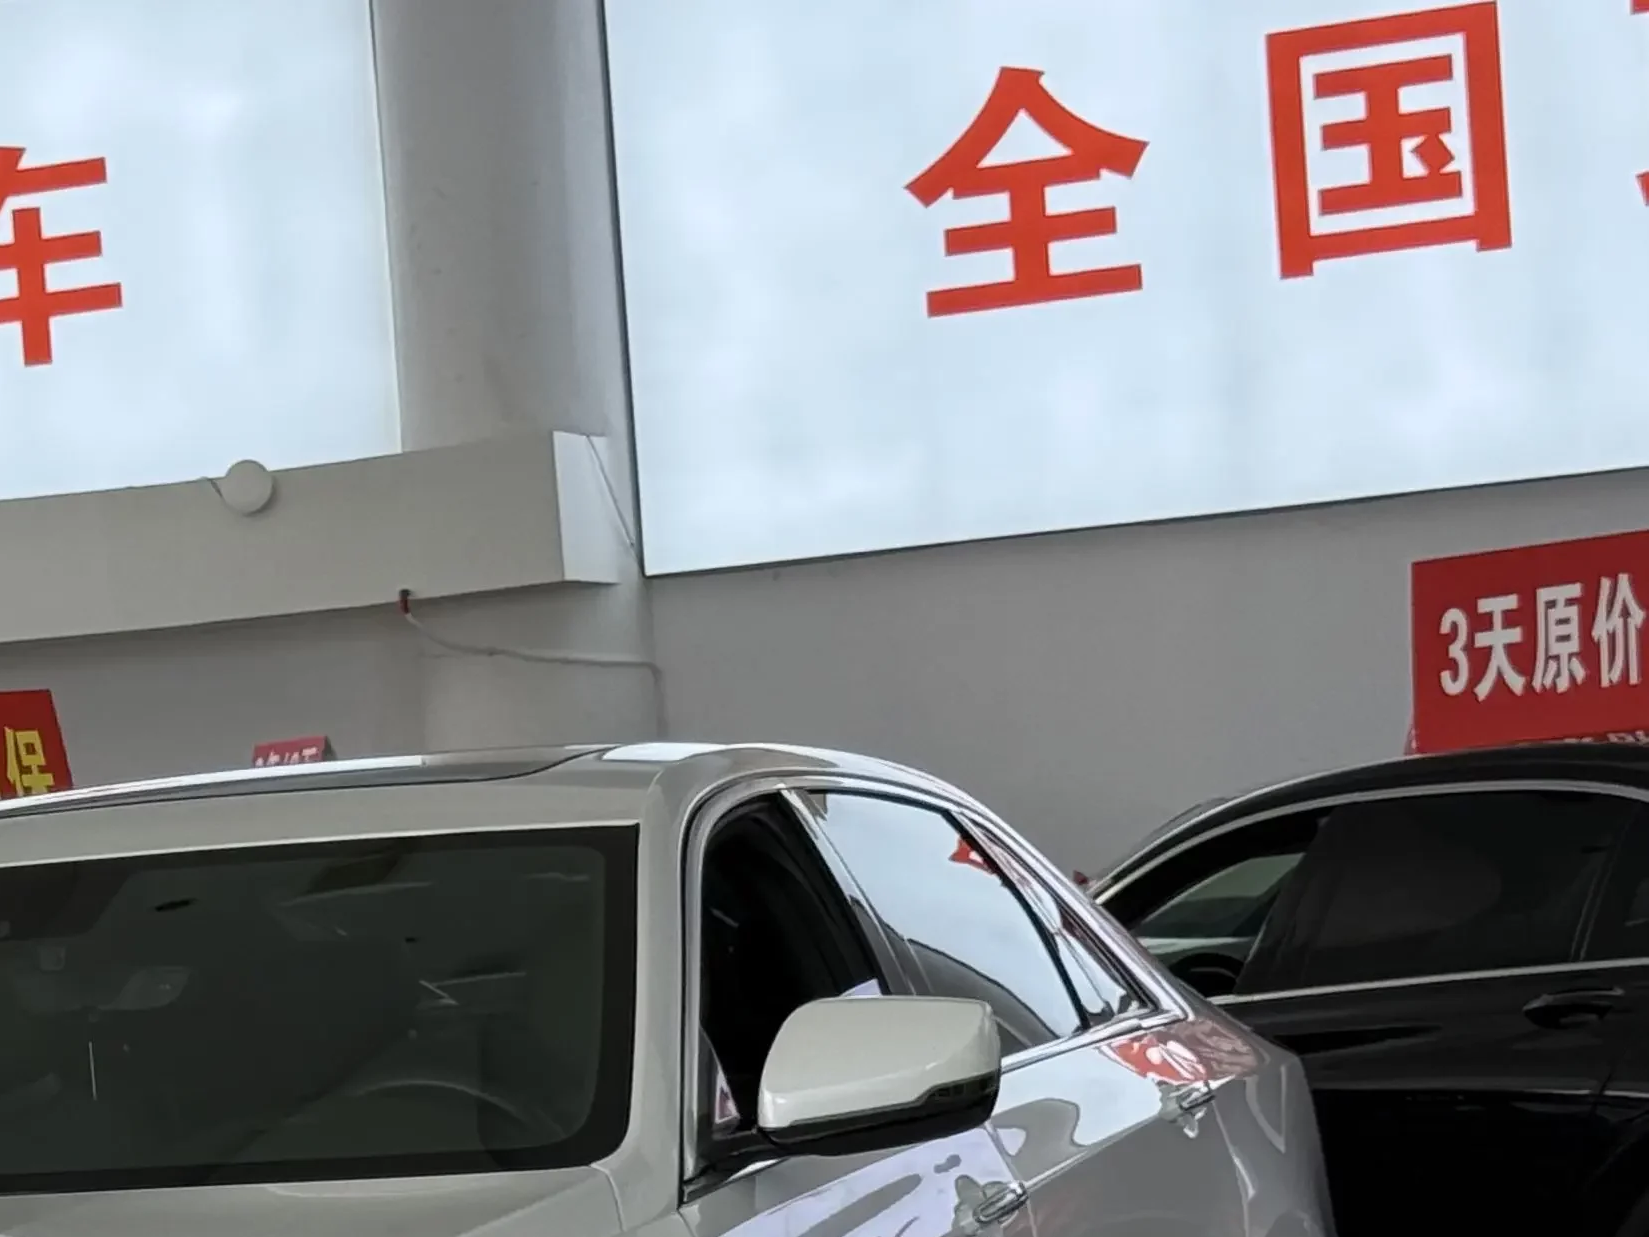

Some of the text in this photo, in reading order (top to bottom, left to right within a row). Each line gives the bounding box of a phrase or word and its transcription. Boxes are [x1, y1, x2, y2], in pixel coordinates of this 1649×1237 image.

[904, 0, 1649, 318] 全国
[1438, 572, 1647, 702] 3天原价
